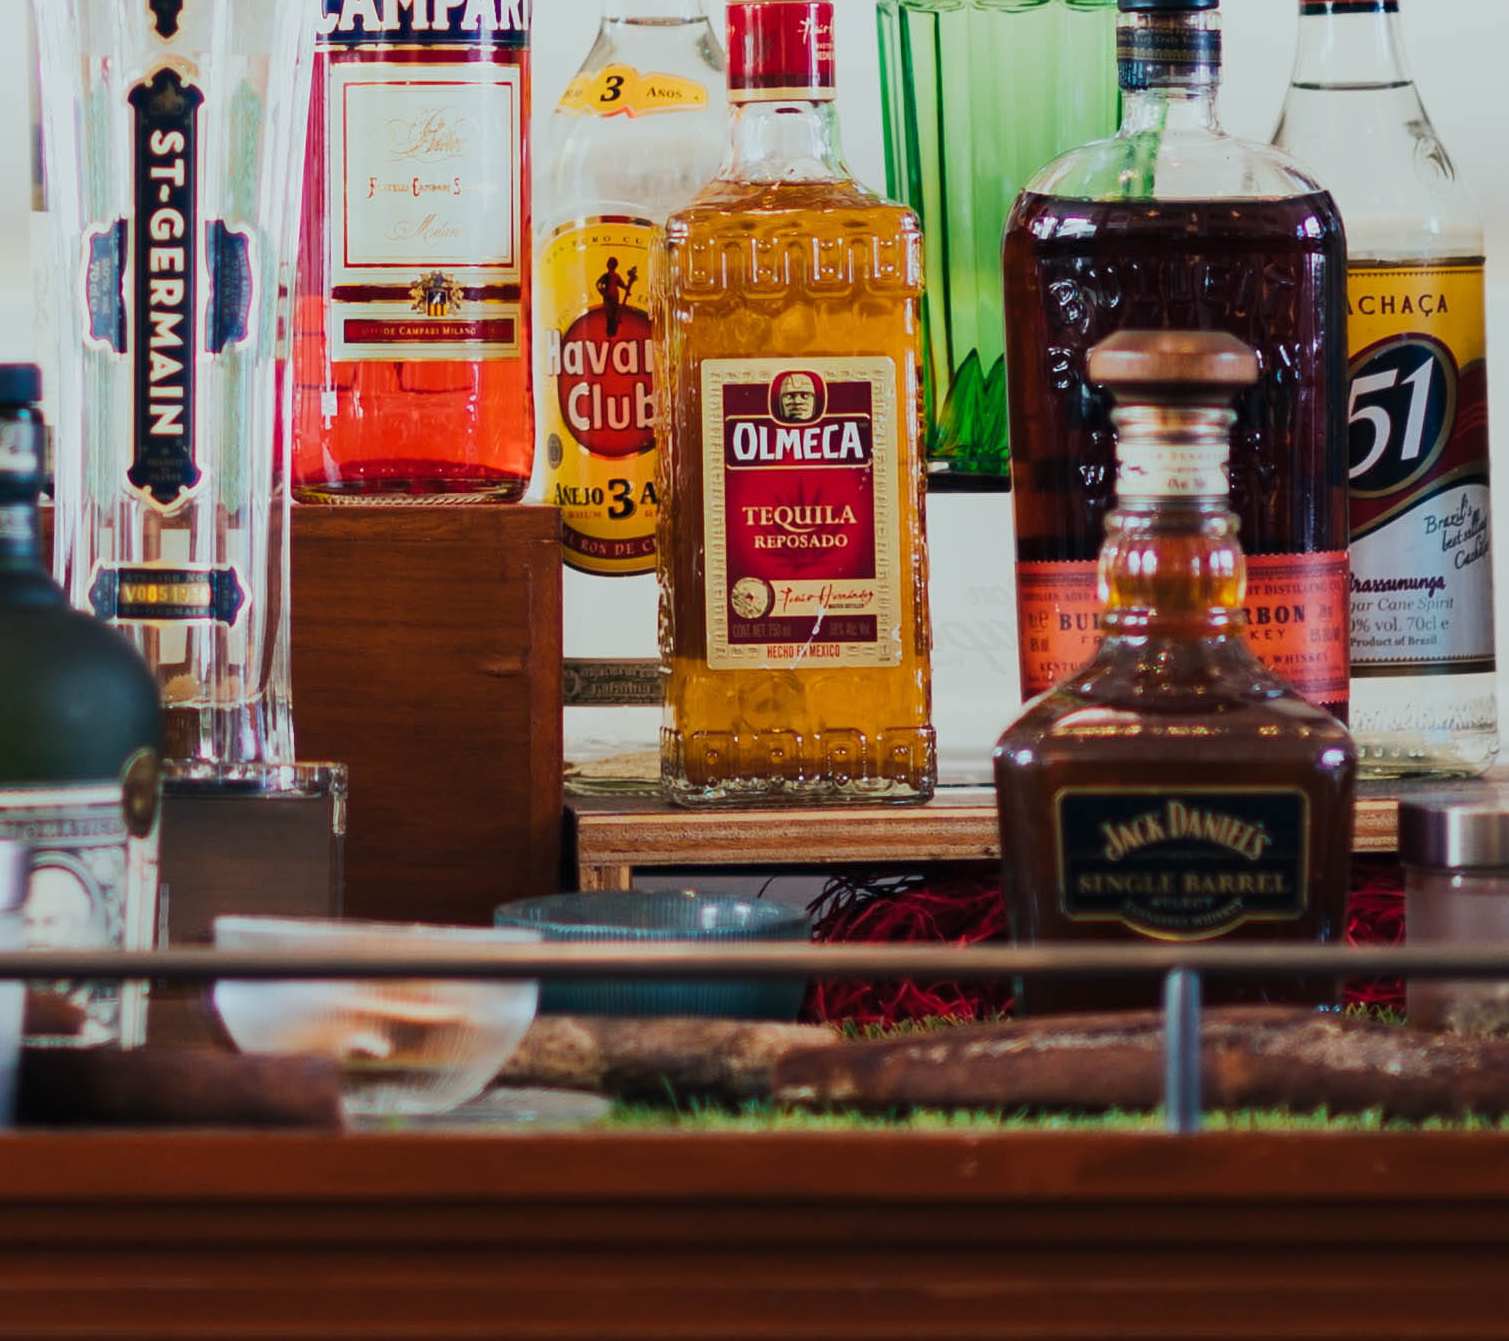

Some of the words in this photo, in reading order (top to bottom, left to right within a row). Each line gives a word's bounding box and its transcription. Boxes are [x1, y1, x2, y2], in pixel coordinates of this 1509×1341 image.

[600, 75, 625, 102] 3
[1348, 355, 1435, 480] 51
[733, 421, 864, 461] OLMECA
[607, 478, 637, 520] 3
[741, 505, 858, 533] TEQUILA
[580, 538, 608, 556] RON
[613, 540, 635, 557] DE
[753, 534, 849, 549] REPOSADO
[1377, 597, 1415, 612] Cane
[1416, 595, 1455, 614] Spirit
[766, 645, 794, 659] HECHO
[809, 644, 841, 658] MEXICO
[1394, 634, 1405, 646] of
[1099, 811, 1165, 862] JACK
[1165, 799, 1273, 862] DANIEL'S
[1078, 872, 1175, 894] SINGLE
[1183, 872, 1291, 894] BARREL
